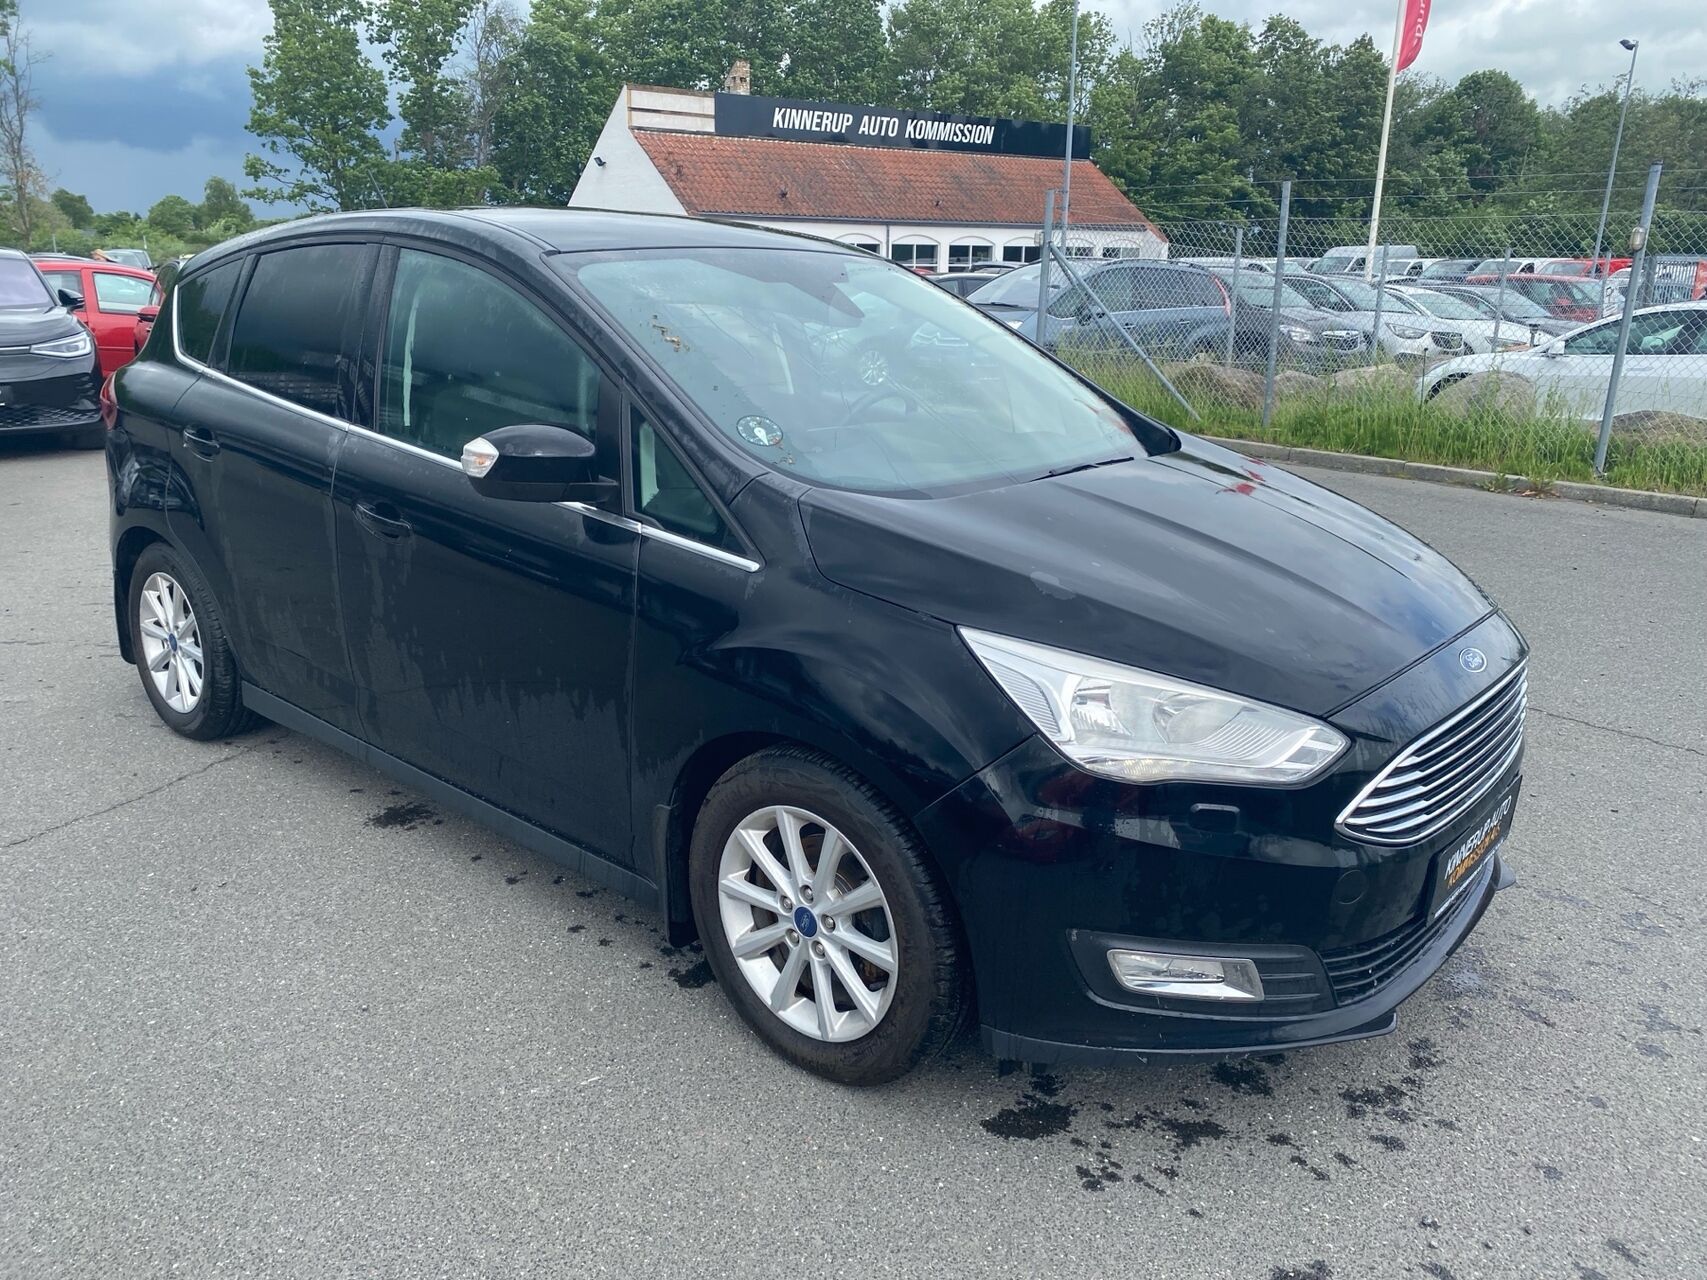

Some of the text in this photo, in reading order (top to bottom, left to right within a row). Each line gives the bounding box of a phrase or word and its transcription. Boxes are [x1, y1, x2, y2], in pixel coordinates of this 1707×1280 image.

[772, 107, 995, 145] KINNERUP AUTO KOMMISSION
